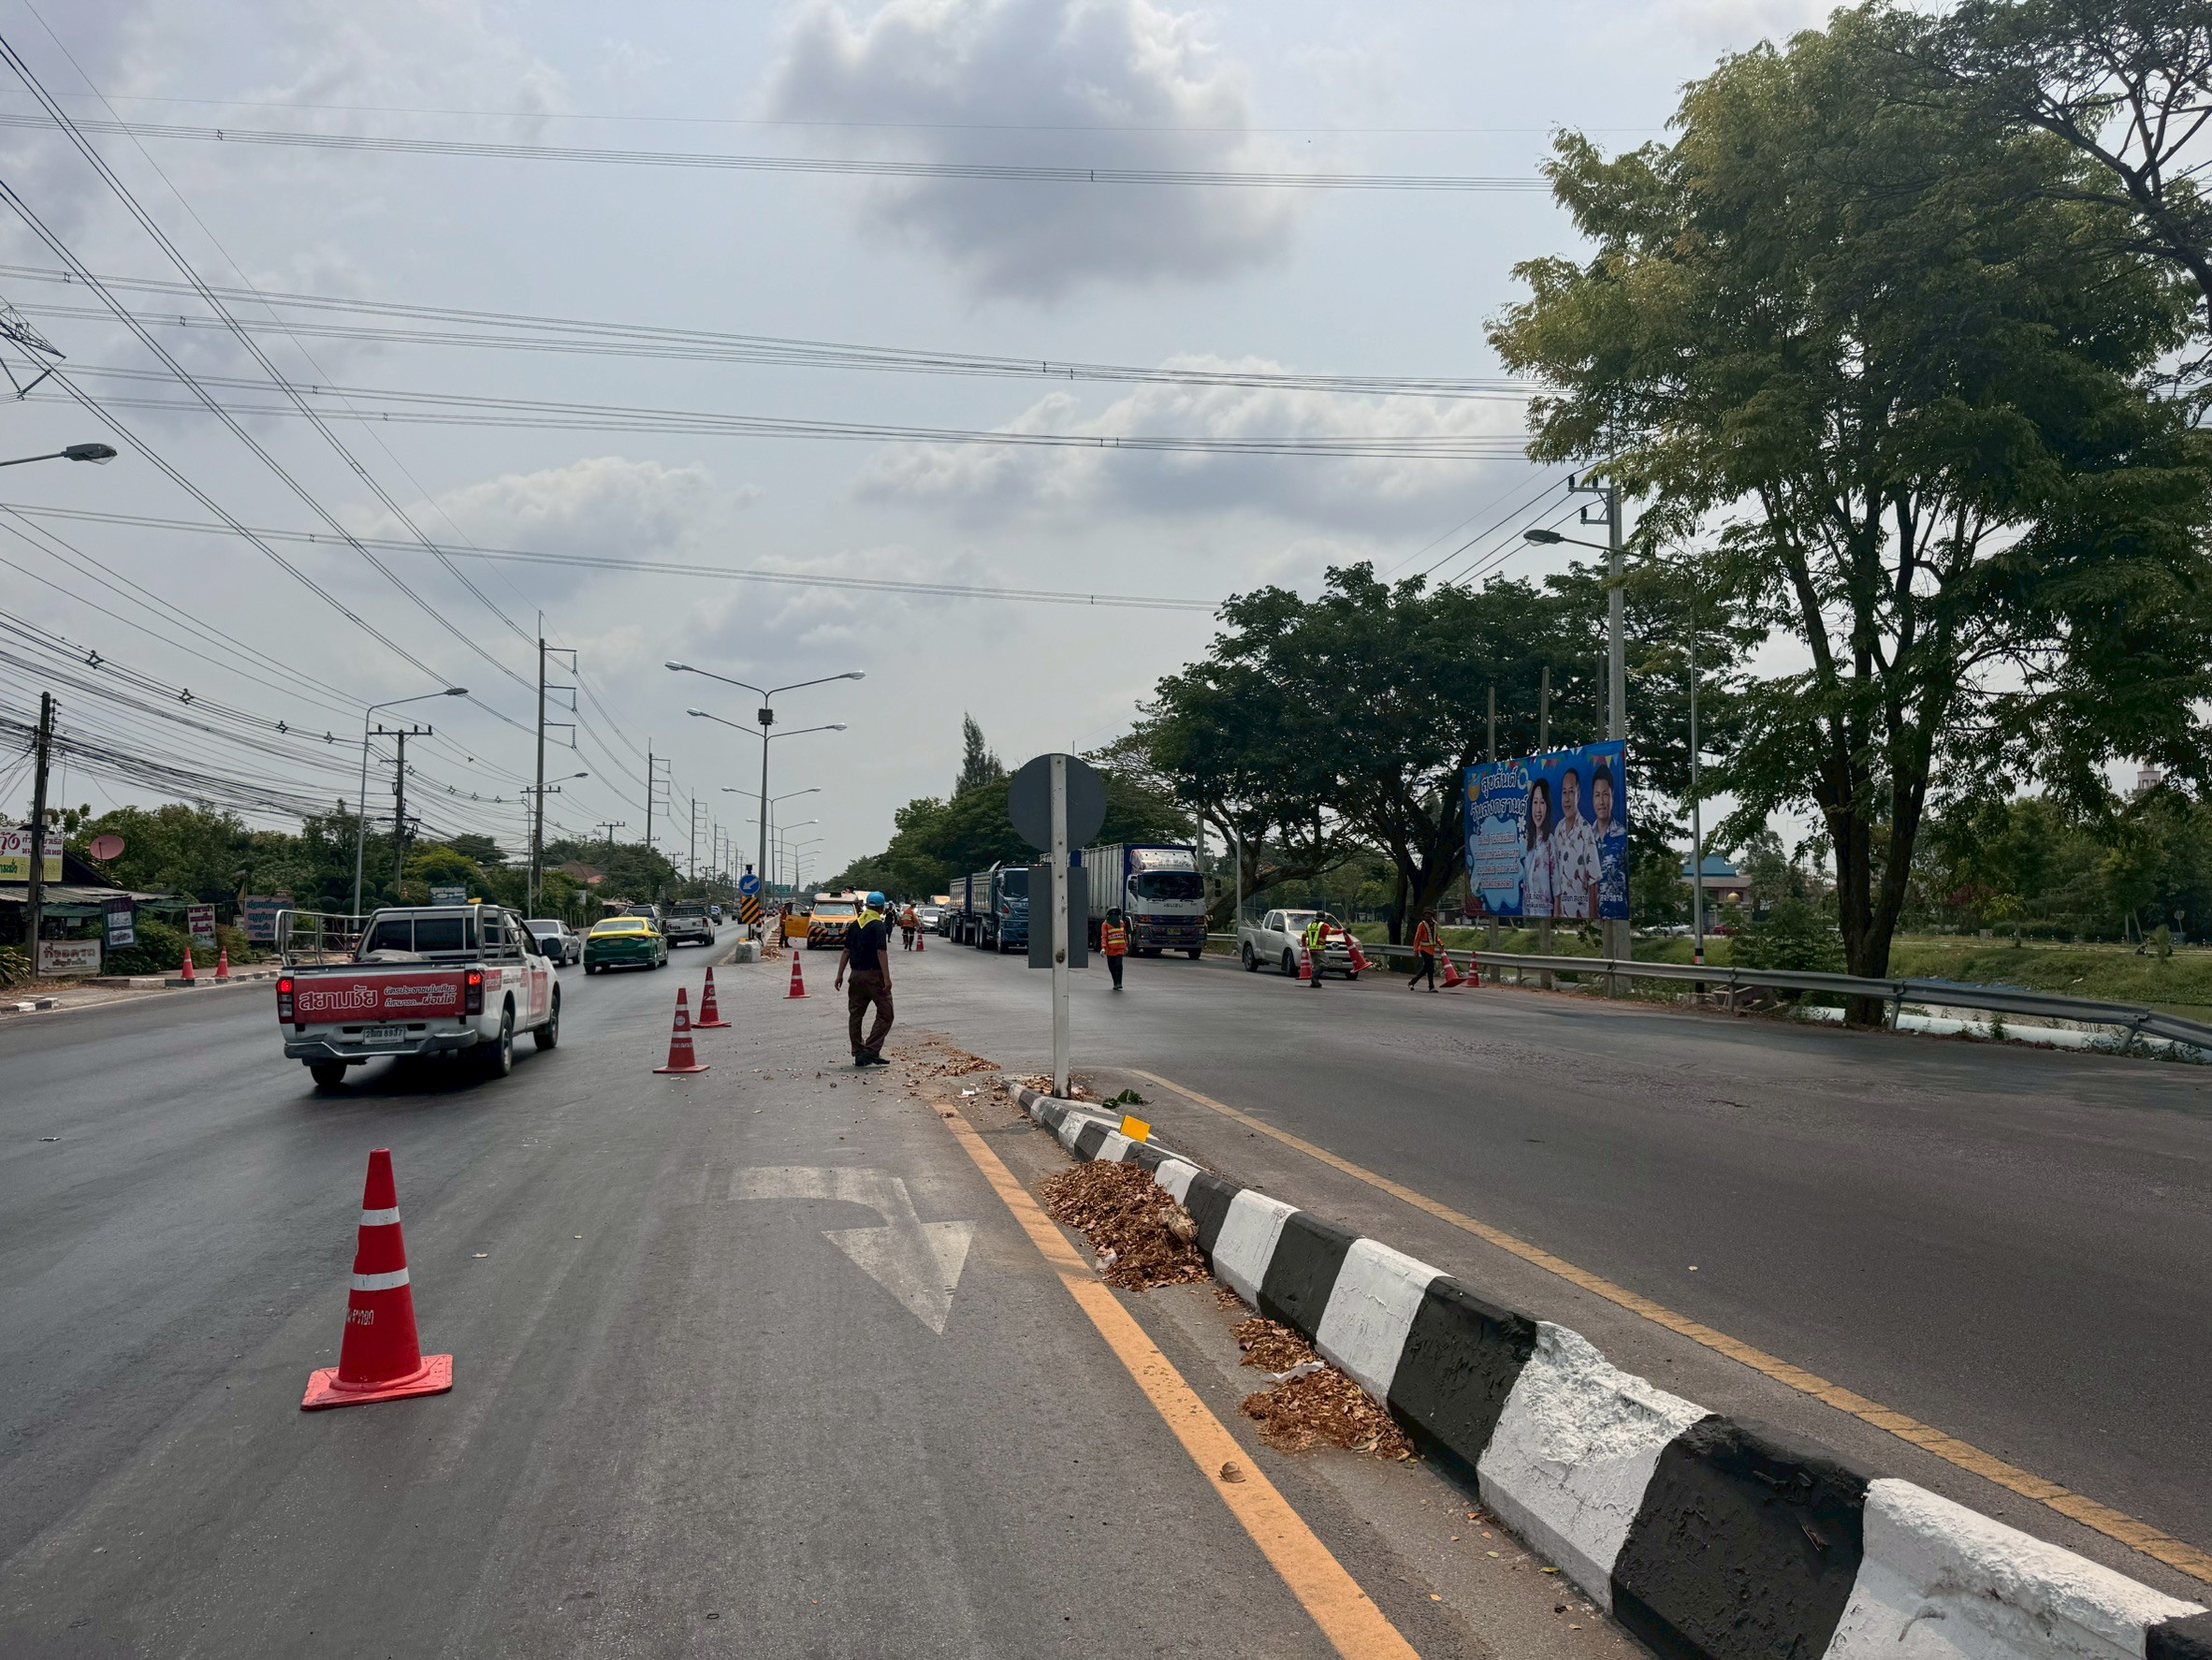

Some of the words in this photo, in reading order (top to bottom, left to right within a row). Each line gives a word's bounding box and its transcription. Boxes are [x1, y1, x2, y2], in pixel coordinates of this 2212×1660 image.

[1481, 766, 1518, 799] สุขสันต์
[1470, 794, 1529, 823] วันสงกรานต์
[298, 985, 378, 1011] สยามชัย
